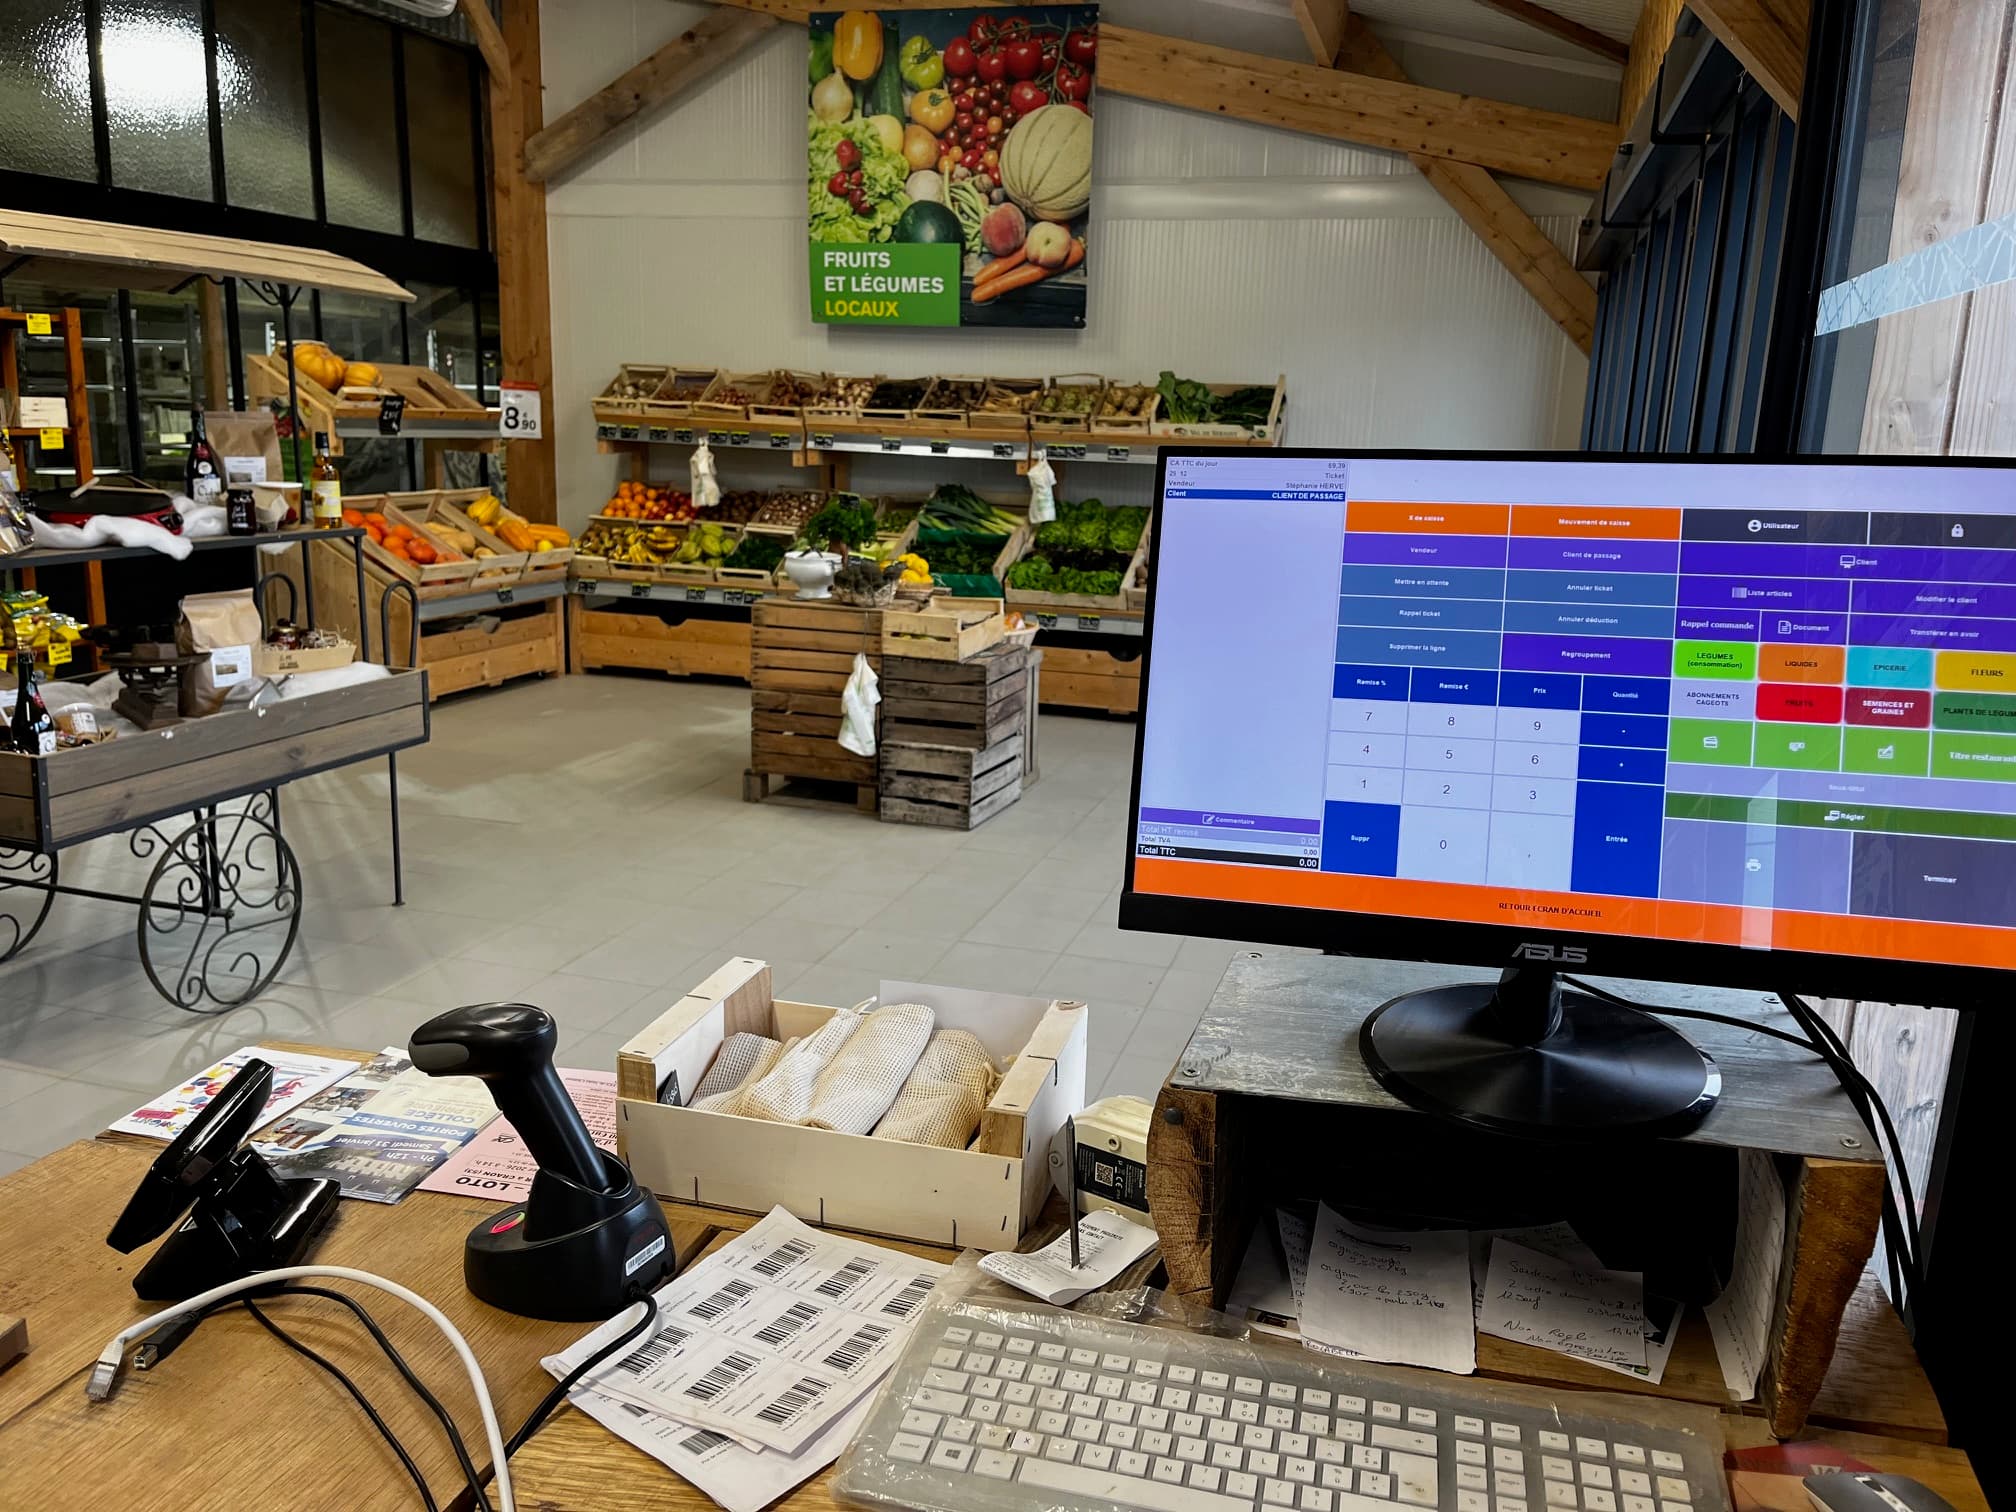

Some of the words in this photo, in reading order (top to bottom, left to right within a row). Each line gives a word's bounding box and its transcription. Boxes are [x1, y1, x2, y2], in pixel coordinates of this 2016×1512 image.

[824, 251, 891, 268] FRUITS
[824, 276, 846, 292] ET
[851, 273, 944, 293] LÉGUMES
[825, 300, 899, 317] LOCAUX
[504, 406, 519, 429] 8
[1285, 482, 1318, 490] Stéphanie
[1309, 492, 1344, 500] PASSAGE
[1558, 518, 1598, 526] Mouvement
[1608, 519, 1631, 527] caisse
[1763, 522, 1800, 530] Utilisateur
[1562, 551, 1582, 559] Client
[1583, 552, 1592, 560] de
[1593, 553, 1621, 561] passage
[1856, 558, 1877, 566] Client
[1394, 578, 1416, 586] Mettre
[1427, 579, 1449, 587] attente
[1567, 584, 1592, 592] Annuler
[1747, 589, 1763, 597] Liste
[1764, 590, 1793, 598] articles
[1916, 594, 1948, 603] Modifier
[1958, 596, 1978, 604] client
[1399, 609, 1422, 618] Rappel
[1423, 610, 1441, 618] ticket
[1558, 615, 1584, 624] Annuler
[1585, 616, 1619, 625] déduction
[1681, 620, 1709, 631] Rappel
[1710, 621, 1755, 630] commande
[1793, 623, 1830, 632] Document
[1910, 628, 1947, 637] Transférer
[1959, 630, 1980, 638] avoir
[1389, 643, 1421, 652] Supprimer
[1429, 644, 1446, 653] ligne
[1561, 650, 1611, 660] Regroupement
[1696, 652, 1734, 660] LEGUMES
[1687, 660, 1743, 670] (consommation)
[1785, 660, 1818, 668] LIQUIDES
[1873, 664, 1907, 672] EPICERIE
[1970, 668, 2004, 677] FLEURS
[1356, 678, 1378, 686] Remise
[1439, 682, 1462, 690] Remise
[1533, 687, 1546, 695] Prix
[1612, 690, 1639, 699] Quantité
[1686, 691, 1740, 700] ABONNEMENTS
[1696, 699, 1729, 707] CAGEOTS
[1785, 699, 1814, 708] FRUITS
[1862, 700, 1902, 709] SEMENCES
[1904, 701, 1914, 709] ET
[1871, 707, 1904, 716] GRAINES
[1943, 707, 1974, 716] PLANTS
[1365, 711, 1373, 722] 7
[1447, 716, 1456, 726] 8
[1533, 720, 1541, 731] 9
[1363, 744, 1371, 755] 4
[1445, 749, 1453, 760] 5
[1950, 751, 1970, 760] Titre
[1531, 754, 1539, 765] 6
[1442, 784, 1451, 795] 2
[1528, 789, 1537, 800] 3
[1215, 816, 1255, 825] Commentaire
[1840, 812, 1865, 821] Régler
[1141, 825, 1158, 834] Total
[1161, 826, 1173, 835] HT
[1140, 835, 1156, 843] Total
[1157, 836, 1171, 844] TVA
[1301, 837, 1318, 846] 0,00
[1350, 834, 1370, 843] Suppr
[1605, 835, 1629, 844] Entrée
[1439, 839, 1447, 850] 0
[1139, 846, 1158, 855] Total
[1159, 847, 1177, 856] TTC
[1303, 848, 1318, 856] 0,00
[1299, 859, 1317, 867] 0,00
[1923, 875, 1957, 884] Terminer
[1498, 902, 1531, 912] RETOUR
[1532, 905, 1559, 914] ECRAN
[1561, 907, 1603, 918] D'ACCUEIL
[1511, 942, 1588, 964] ASUS
[403, 1108, 476, 1124] COLLÈGE
[352, 1115, 417, 1130] OUVERTES
[418, 1123, 469, 1137] PORTES
[335, 1137, 374, 1147] janvier
[390, 1139, 433, 1150] Samedi
[386, 1151, 409, 1160] 12h
[421, 1154, 436, 1162] 9h
[464, 1167, 483, 1175] (53)
[483, 1170, 514, 1180] CRAON
[455, 1177, 510, 1191] LOTO
